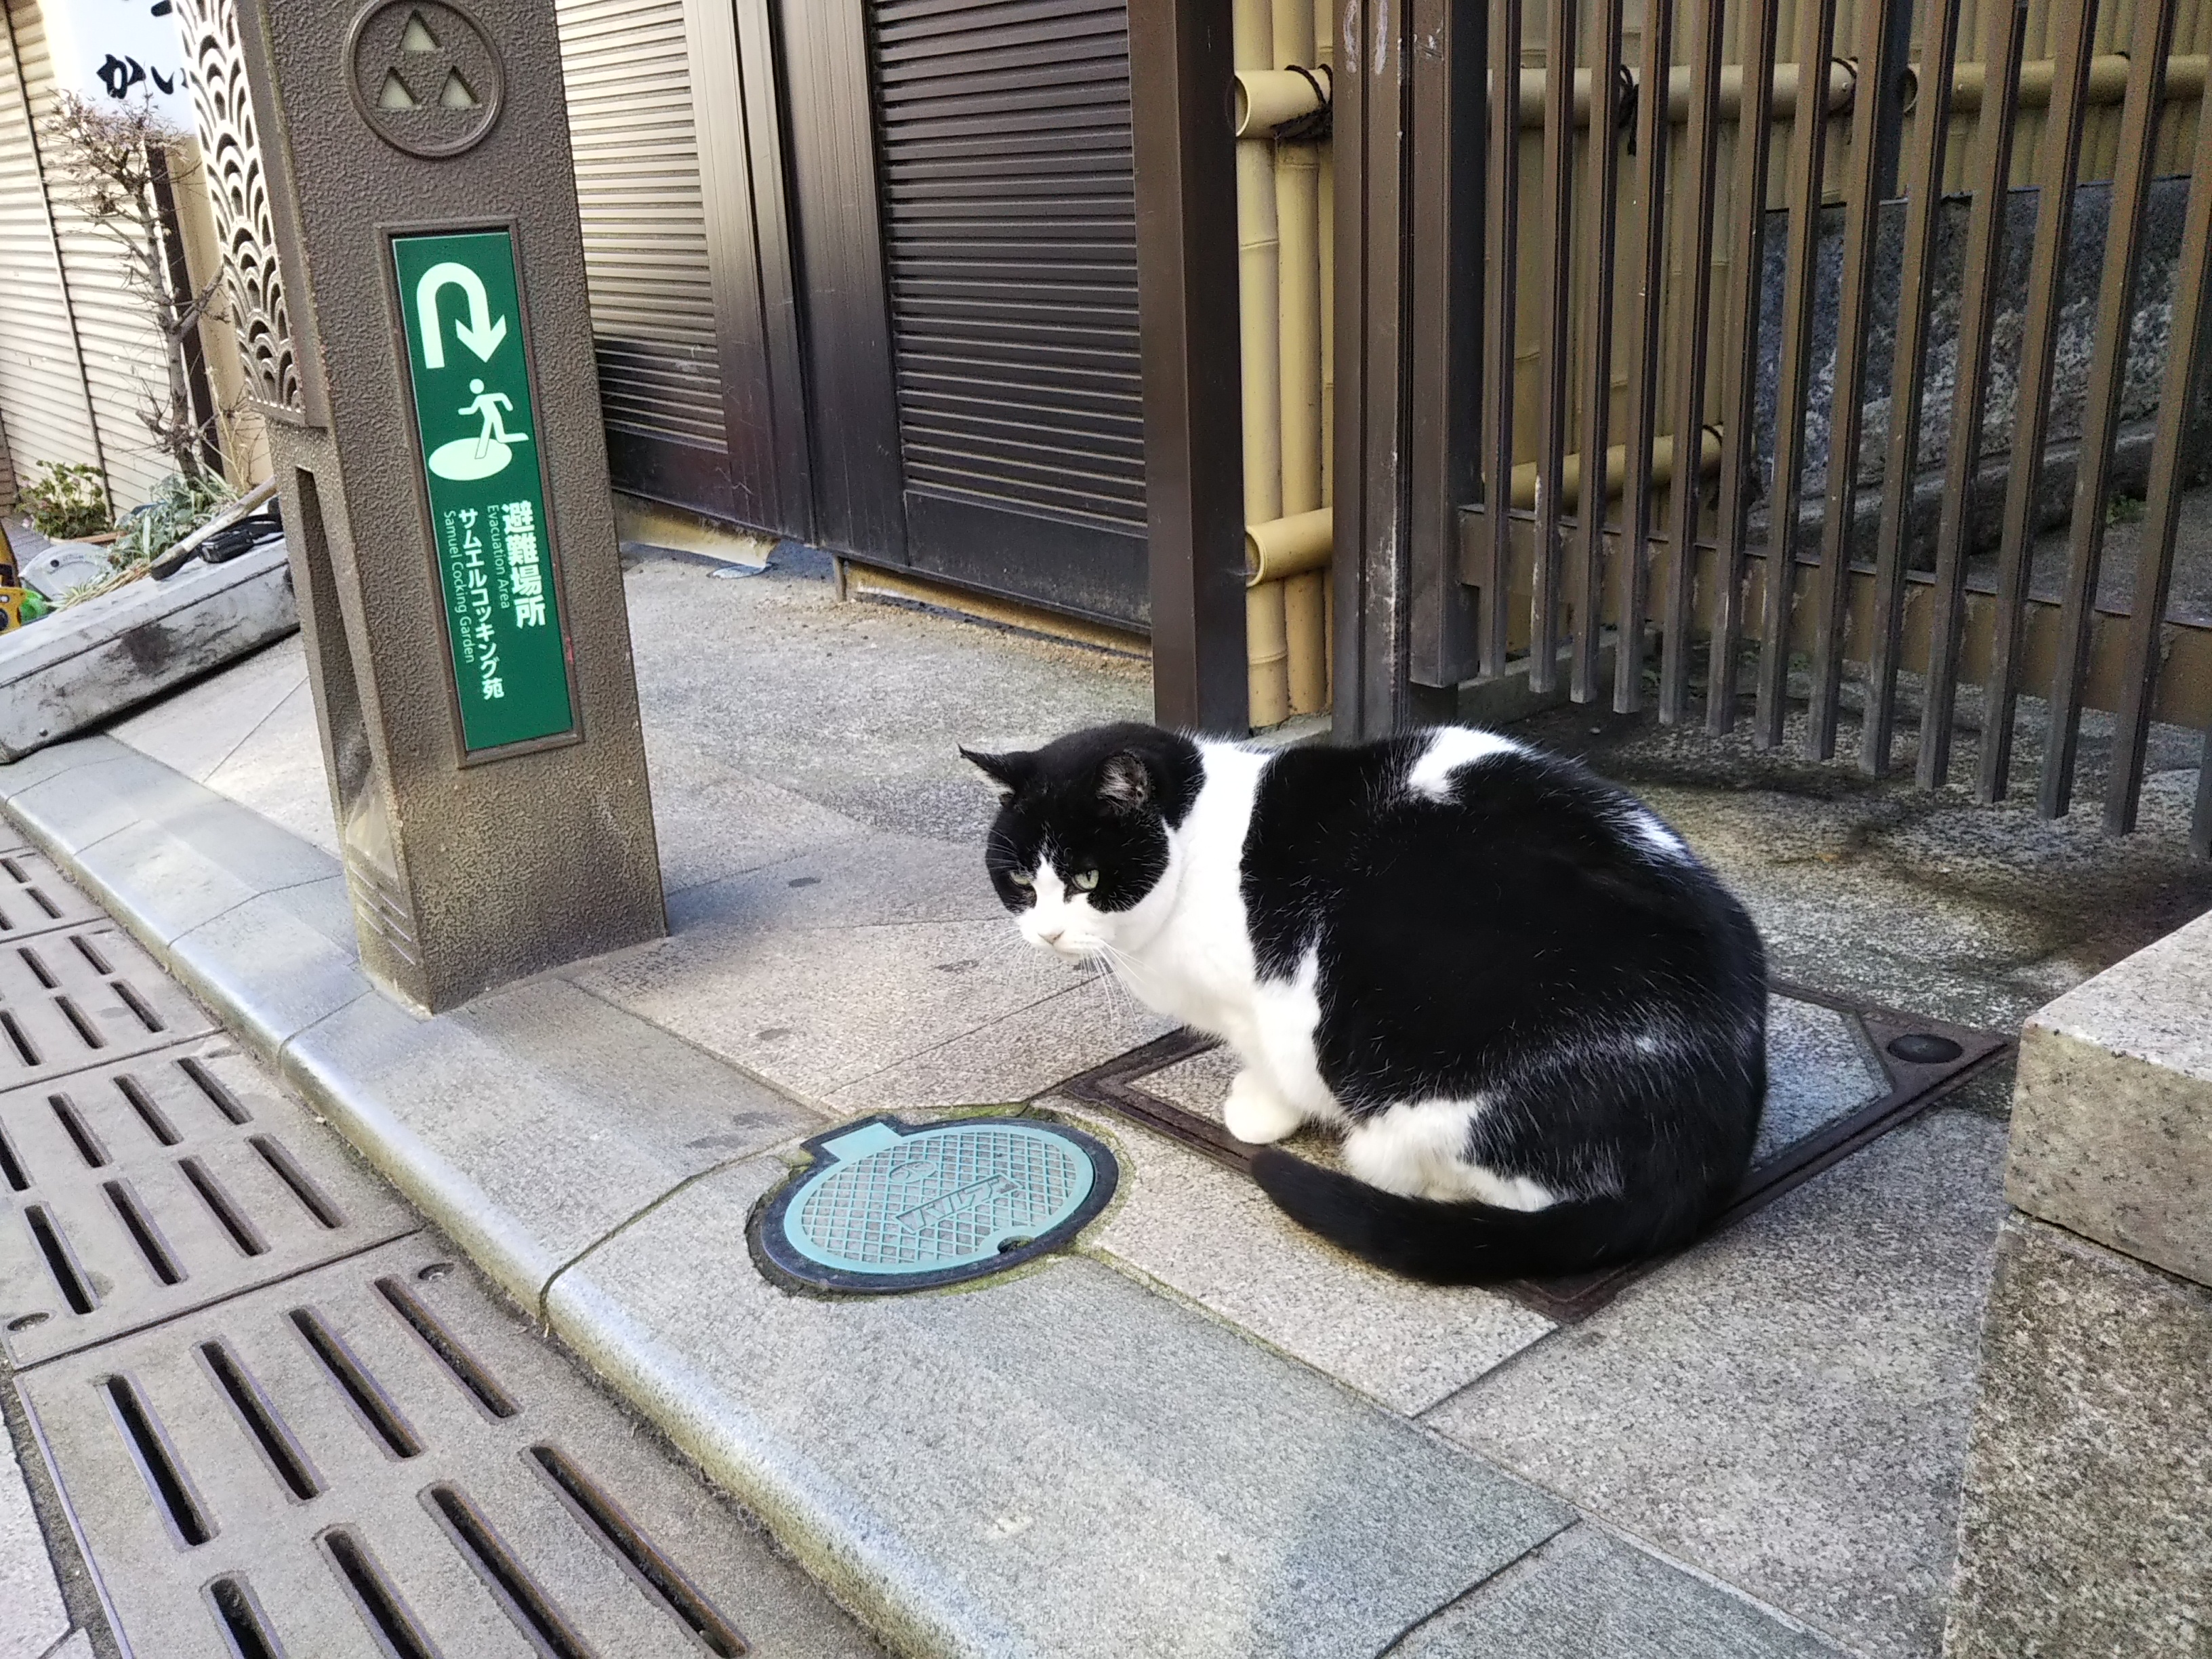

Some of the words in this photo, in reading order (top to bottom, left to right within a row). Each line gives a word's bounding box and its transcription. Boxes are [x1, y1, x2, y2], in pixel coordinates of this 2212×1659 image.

[443, 510, 459, 559] Samuel
[487, 504, 506, 576] Evacuation
[497, 578, 510, 609] Area
[452, 561, 468, 613] Cocking
[501, 500, 546, 629] 避難場所
[459, 507, 505, 701] サムエルコッキング苑
[459, 615, 475, 664] Garden
[915, 1178, 1000, 1229] バルブ
